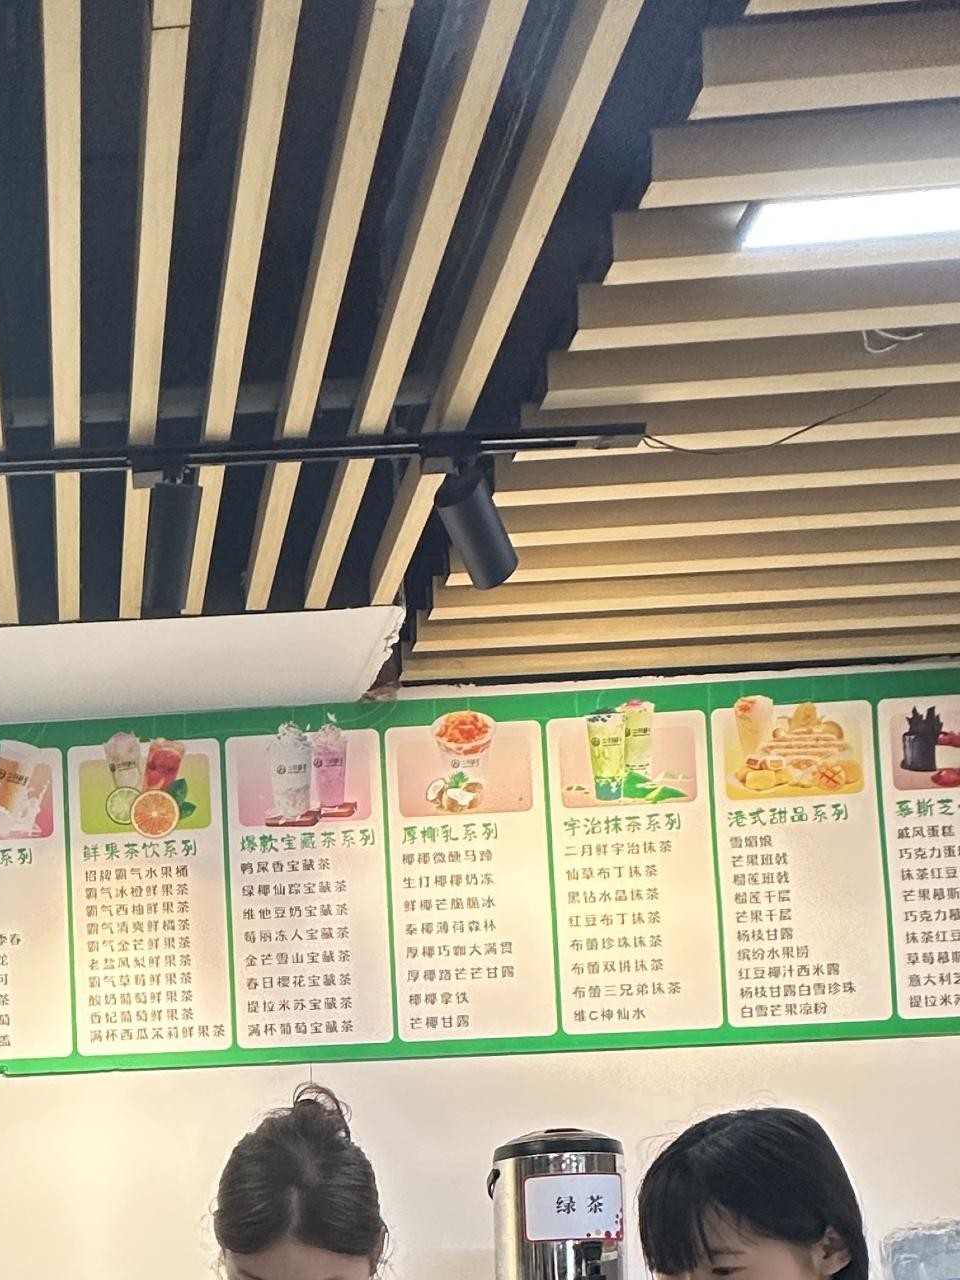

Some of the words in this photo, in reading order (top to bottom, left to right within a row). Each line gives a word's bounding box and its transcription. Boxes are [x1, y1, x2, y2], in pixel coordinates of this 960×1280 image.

[728, 803, 848, 827] 港式甜品系列
[896, 798, 960, 818] 慕斯芝
[564, 813, 680, 836] 宇治抹茶系列
[897, 825, 955, 840] 戚风蛋糕
[240, 828, 375, 854] 爆款宝藏茶系列
[402, 822, 498, 845] 厚椰乳系列
[729, 835, 772, 848] 雪媚娘
[83, 839, 197, 863] 鲜果茶饮系列
[564, 840, 672, 857] 二月鲜宇治抹茶
[241, 858, 330, 875] 鸭屎香宝藏茶
[732, 853, 788, 868] 芒果班戟
[85, 865, 188, 882] 招牌霸气水果桶
[403, 873, 494, 889] 生打椰椰奶冻
[566, 864, 658, 881] 仙草布丁抹茶
[733, 872, 789, 886] 榴莲班戟
[85, 884, 189, 900] 霸气冰橙鲜果茶
[242, 880, 347, 897] 绿椰仙踪宝藏茶
[568, 888, 659, 904] 黑钻水晶抹茶
[404, 896, 495, 912] 鲜椰芒脆脆冰
[735, 890, 791, 905] 榴莲千层
[86, 901, 189, 918] 霸气西柚鲜果茶
[243, 904, 349, 920] 维他豆奶宝藏茶
[736, 908, 792, 923] 芒果千层
[87, 919, 190, 935] 霸气清爽鲜橘茶
[569, 911, 661, 927] 红豆布丁抹茶
[570, 934, 662, 951] 布蕾珍珠抹茶
[737, 927, 793, 942] 杨枝甘露
[88, 937, 191, 953] 霸气金芒鲜果茶
[737, 945, 809, 961] 缤纷水果捞
[88, 955, 192, 970] 老盐凤梨鲜果茶
[245, 950, 350, 967] 金芒雪山宝藏茶
[571, 958, 664, 975] 布蕾双拼抹茶
[89, 972, 192, 988] 霸气草莓鲜果茶
[738, 963, 840, 980] 红豆椰汁西米露
[246, 973, 351, 990] 春日樱花宝藏茶
[573, 981, 681, 999] 布蕾三兄弟抹茶
[89, 990, 193, 1006] 酸奶葡萄鲜果茶
[409, 991, 469, 1006] 椰椰拿铁
[740, 982, 855, 1000] 杨枝甘露白雪珍珠
[248, 996, 353, 1014] 提拉米苏宝藏茶
[741, 1001, 827, 1018] 白雪芒果凉粉
[410, 1014, 469, 1030] 芒椰甘露
[574, 1008, 646, 1022] 维C神仙水
[91, 1024, 226, 1042] 满杯西瓜茉莉鲜果茶
[248, 1020, 354, 1037] 满杯葡萄宝藏茶
[556, 1195, 604, 1214] 绿茶
